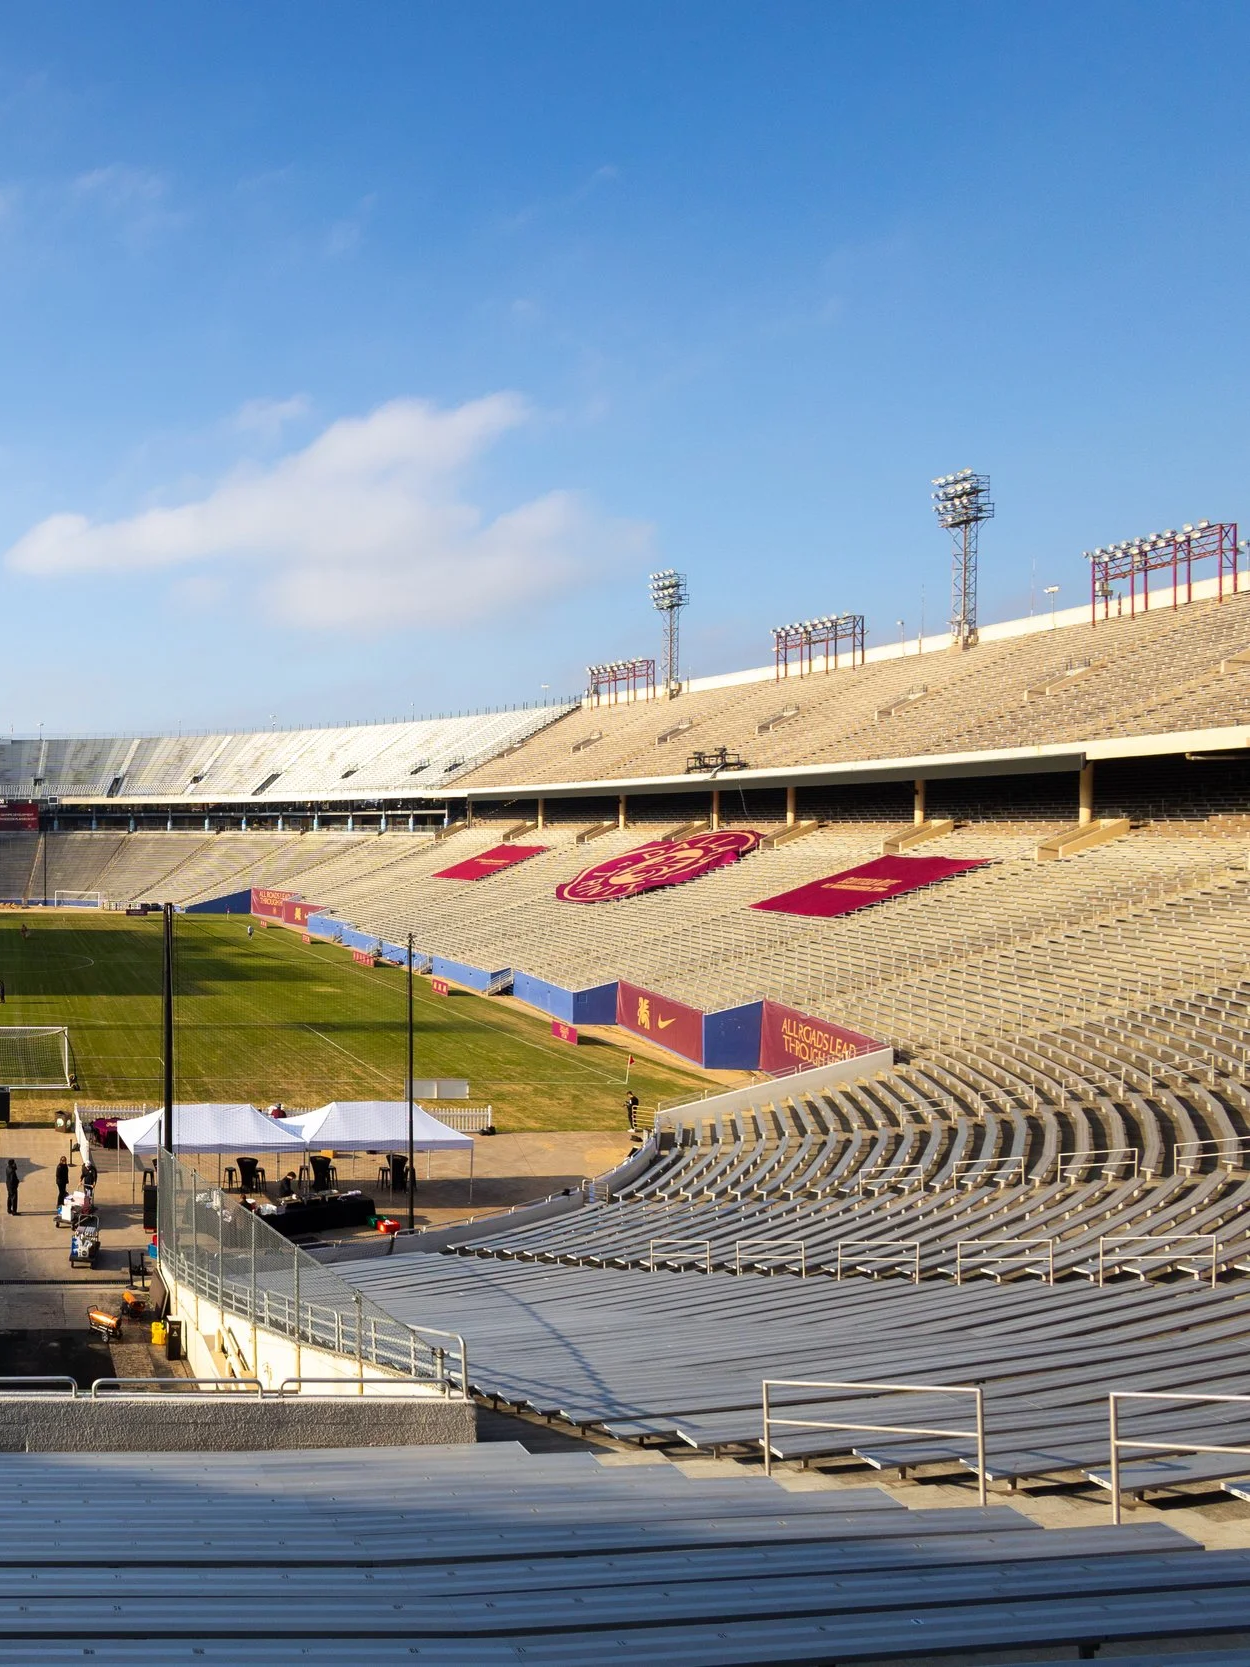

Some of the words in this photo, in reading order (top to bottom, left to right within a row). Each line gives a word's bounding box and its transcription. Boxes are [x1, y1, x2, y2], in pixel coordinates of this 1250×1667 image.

[781, 1017, 799, 1038] ALL
[798, 1023, 830, 1051] ROADS
[829, 1035, 856, 1059] LEAD
[782, 1034, 826, 1068] THROUGH
